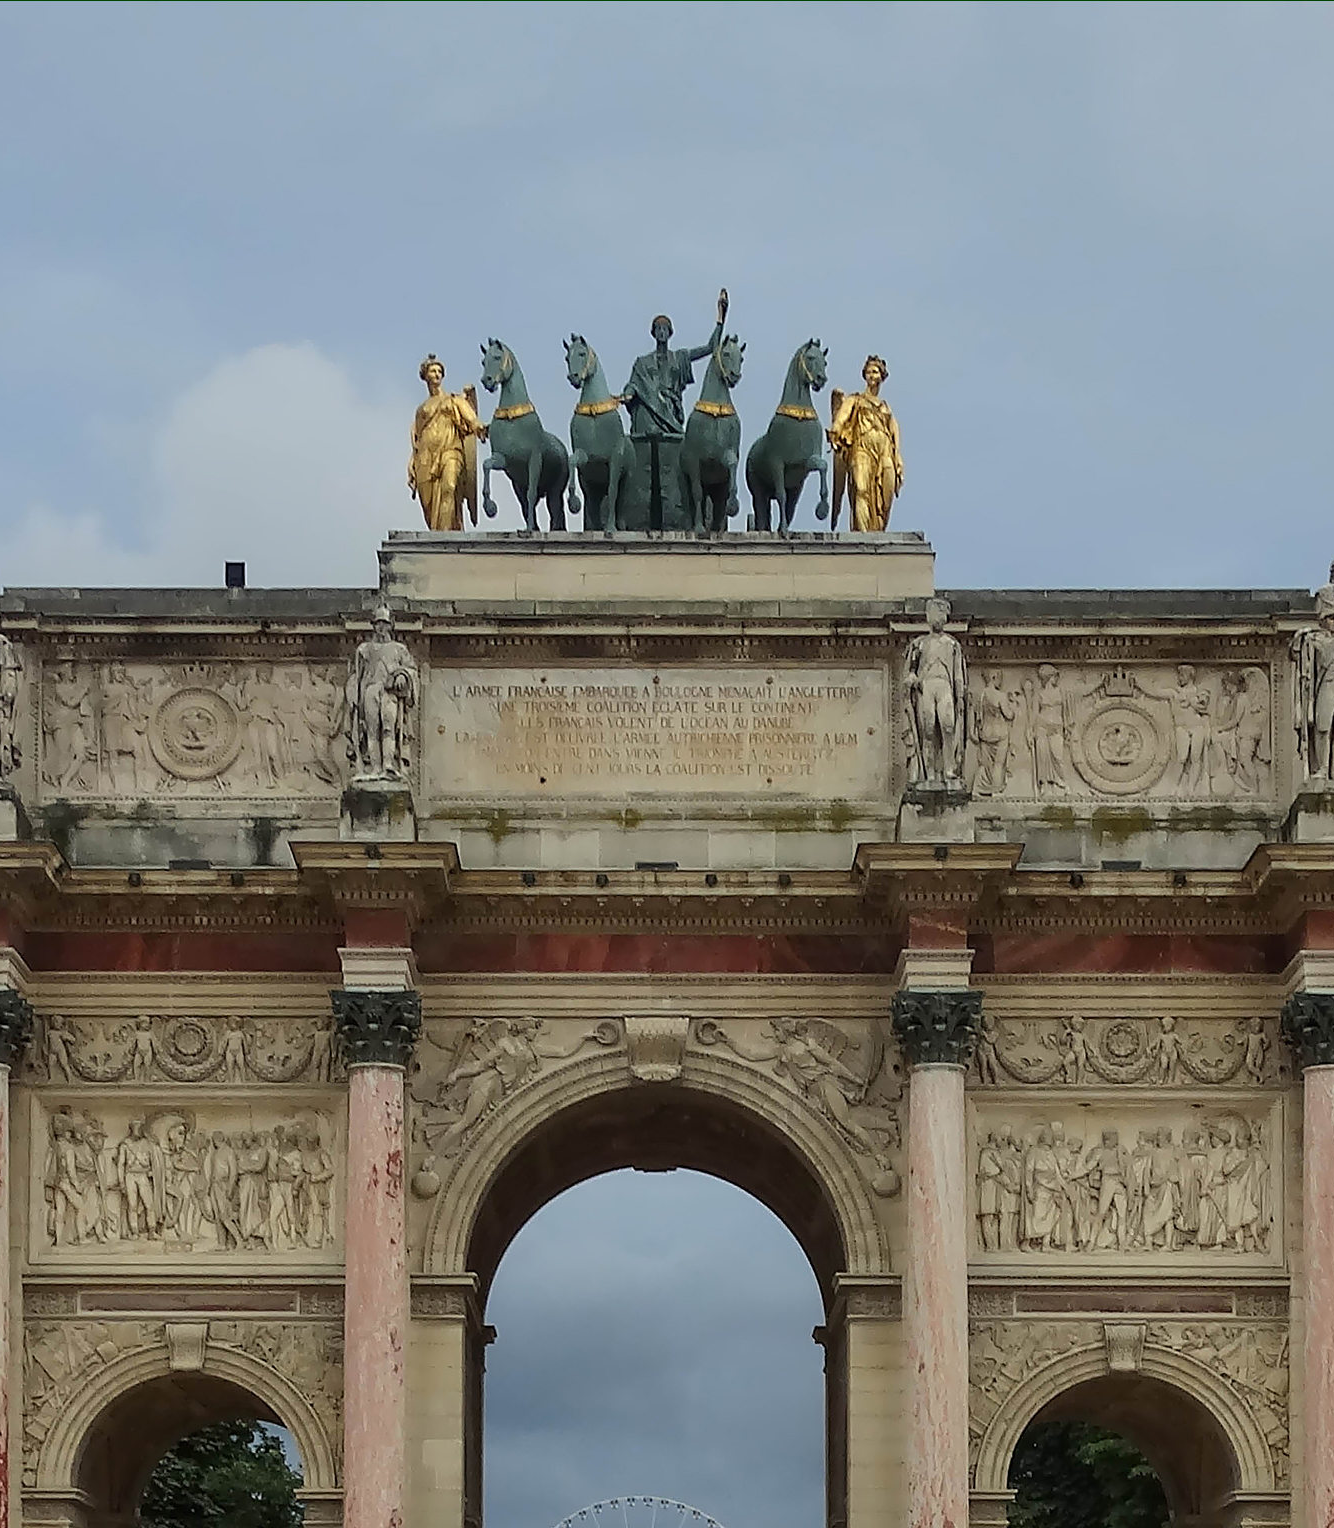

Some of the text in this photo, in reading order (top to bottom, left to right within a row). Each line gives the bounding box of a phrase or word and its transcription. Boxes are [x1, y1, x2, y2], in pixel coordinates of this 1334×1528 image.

[641, 686, 651, 698] A
[654, 686, 714, 699] BOULOGNE
[586, 701, 647, 714] COALITION
[652, 701, 698, 714] ECLATE
[704, 701, 727, 714] SUR
[731, 701, 744, 714] LE
[607, 716, 653, 729] VOLENT
[660, 716, 675, 729] DE
[732, 716, 749, 729] AU
[646, 763, 662, 776] LA
